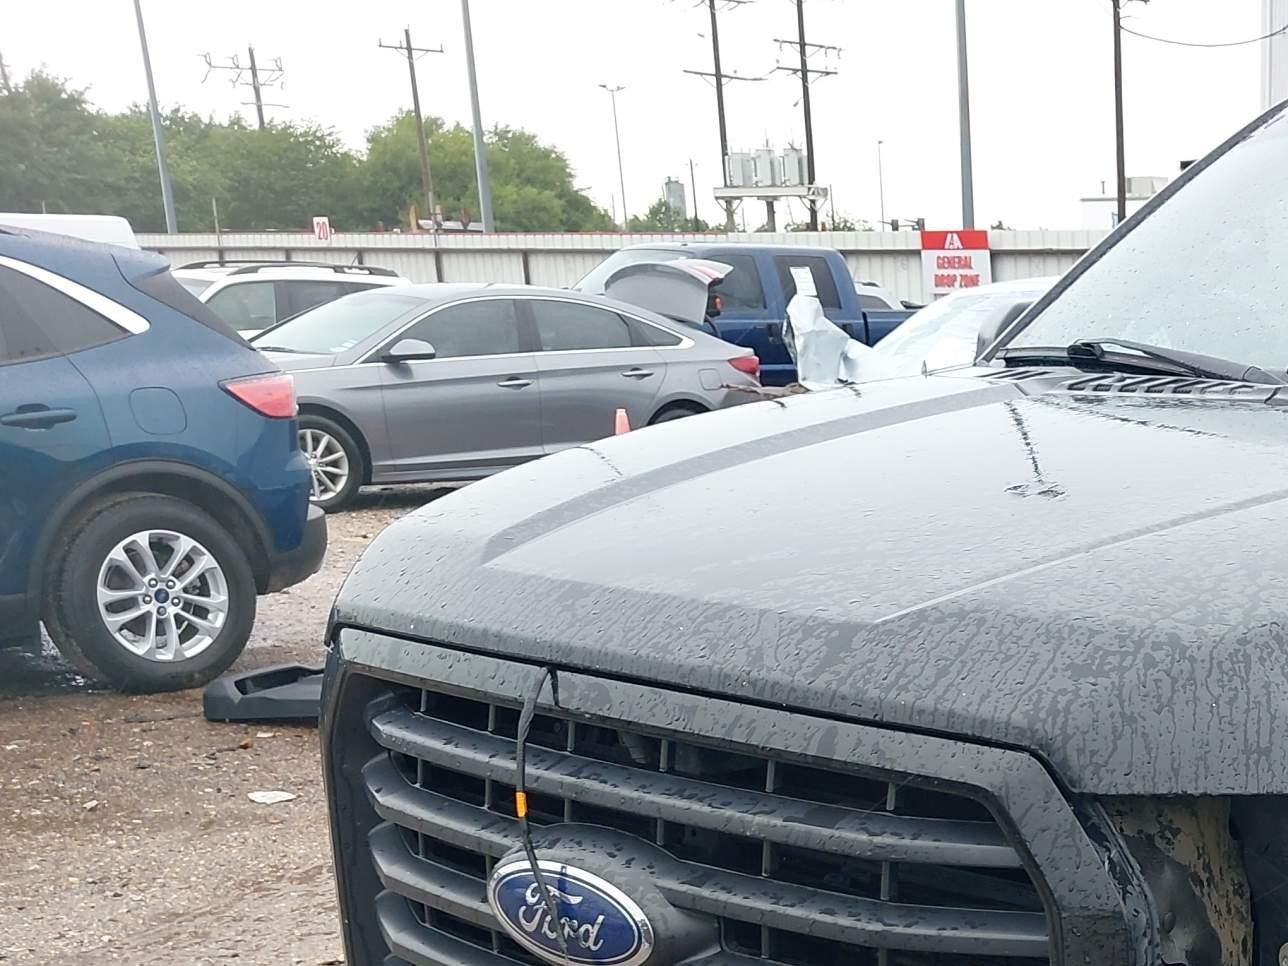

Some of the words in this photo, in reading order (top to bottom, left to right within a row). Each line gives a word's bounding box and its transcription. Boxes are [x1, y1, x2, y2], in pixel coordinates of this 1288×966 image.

[315, 221, 329, 240] 20
[936, 255, 973, 269] GENERAL
[934, 273, 957, 288] DROP
[959, 273, 980, 288] ZONE
[518, 882, 605, 951] Ford
